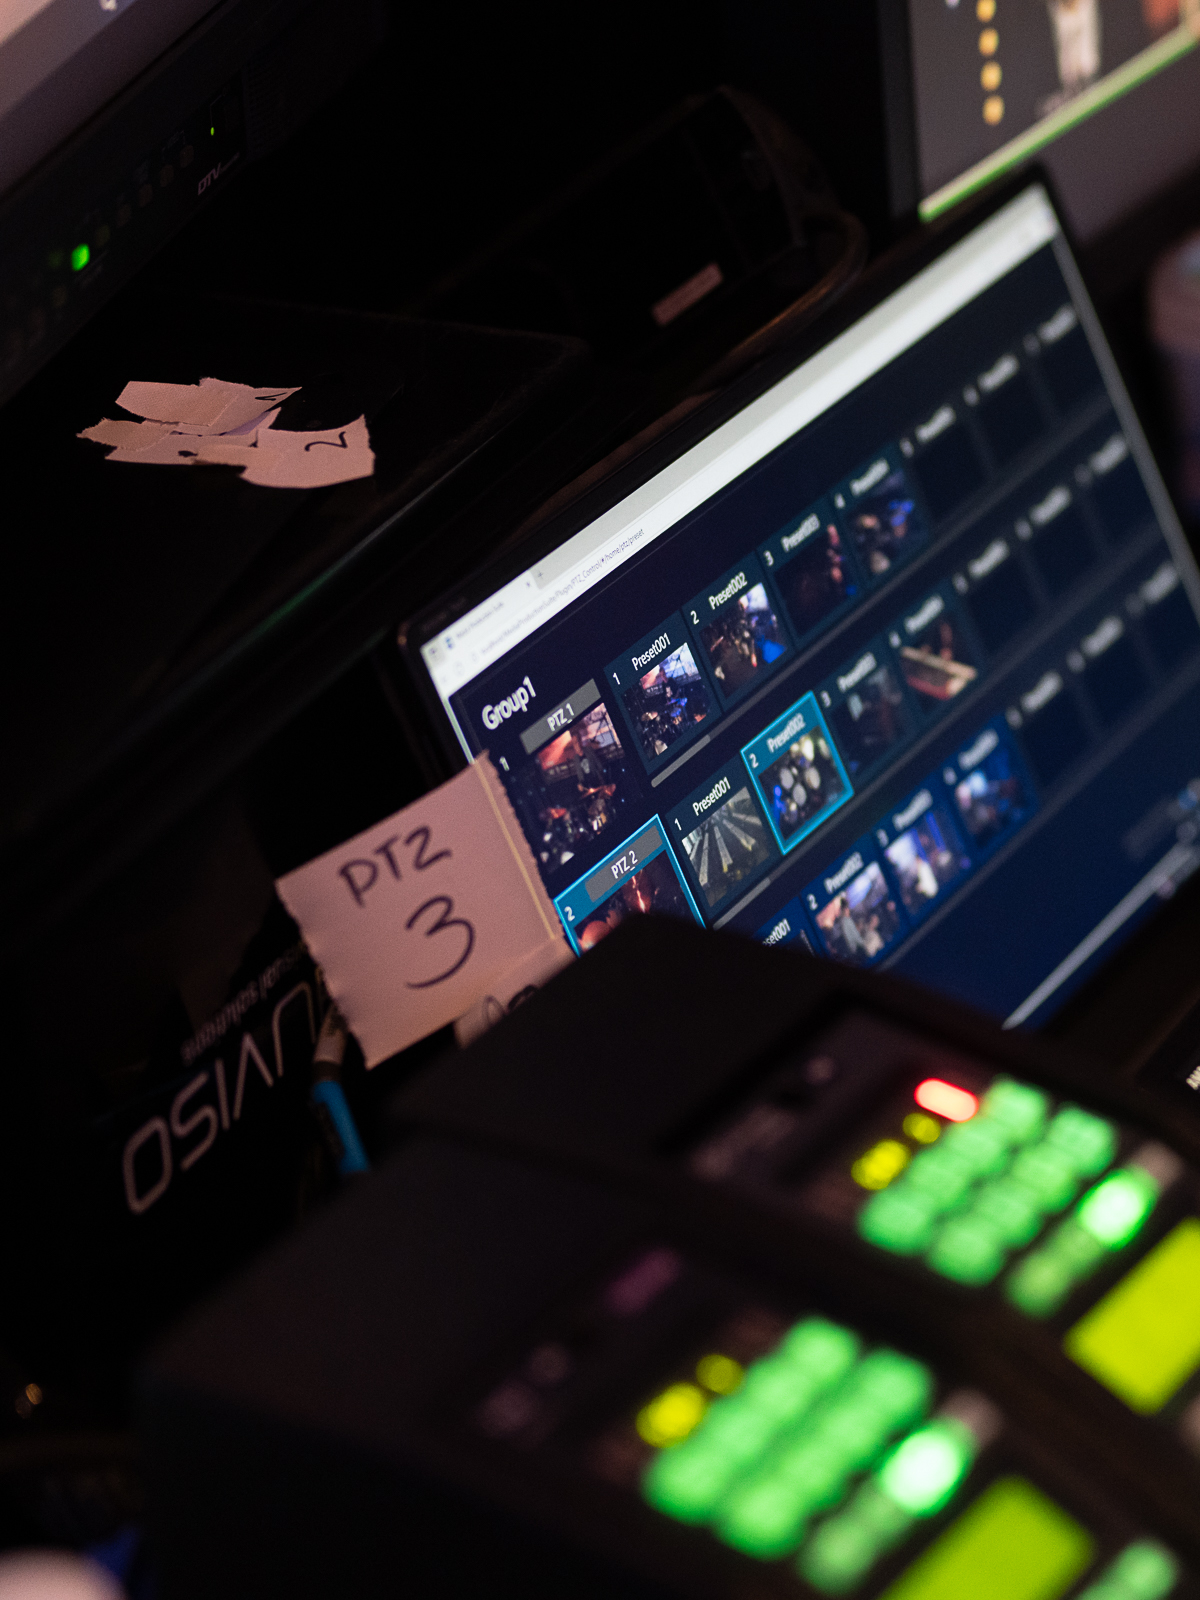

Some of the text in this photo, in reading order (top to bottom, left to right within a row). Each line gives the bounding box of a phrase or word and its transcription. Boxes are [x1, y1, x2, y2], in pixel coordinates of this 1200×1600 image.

[763, 550, 774, 566] 3
[708, 571, 748, 610] Preset002
[690, 610, 700, 625] 2
[631, 632, 671, 671] Preset001
[612, 672, 621, 685] 1
[481, 675, 536, 730] Group1
[546, 703, 574, 732] PTZ_1
[766, 713, 806, 753] Preset002
[499, 756, 510, 771] 1
[749, 753, 759, 768] 2
[692, 776, 731, 817] Preset001
[674, 818, 682, 831] 1
[611, 850, 639, 879] PTZ_2
[807, 894, 818, 910] 2
[564, 906, 576, 921] 2
[405, 895, 476, 989] 3
